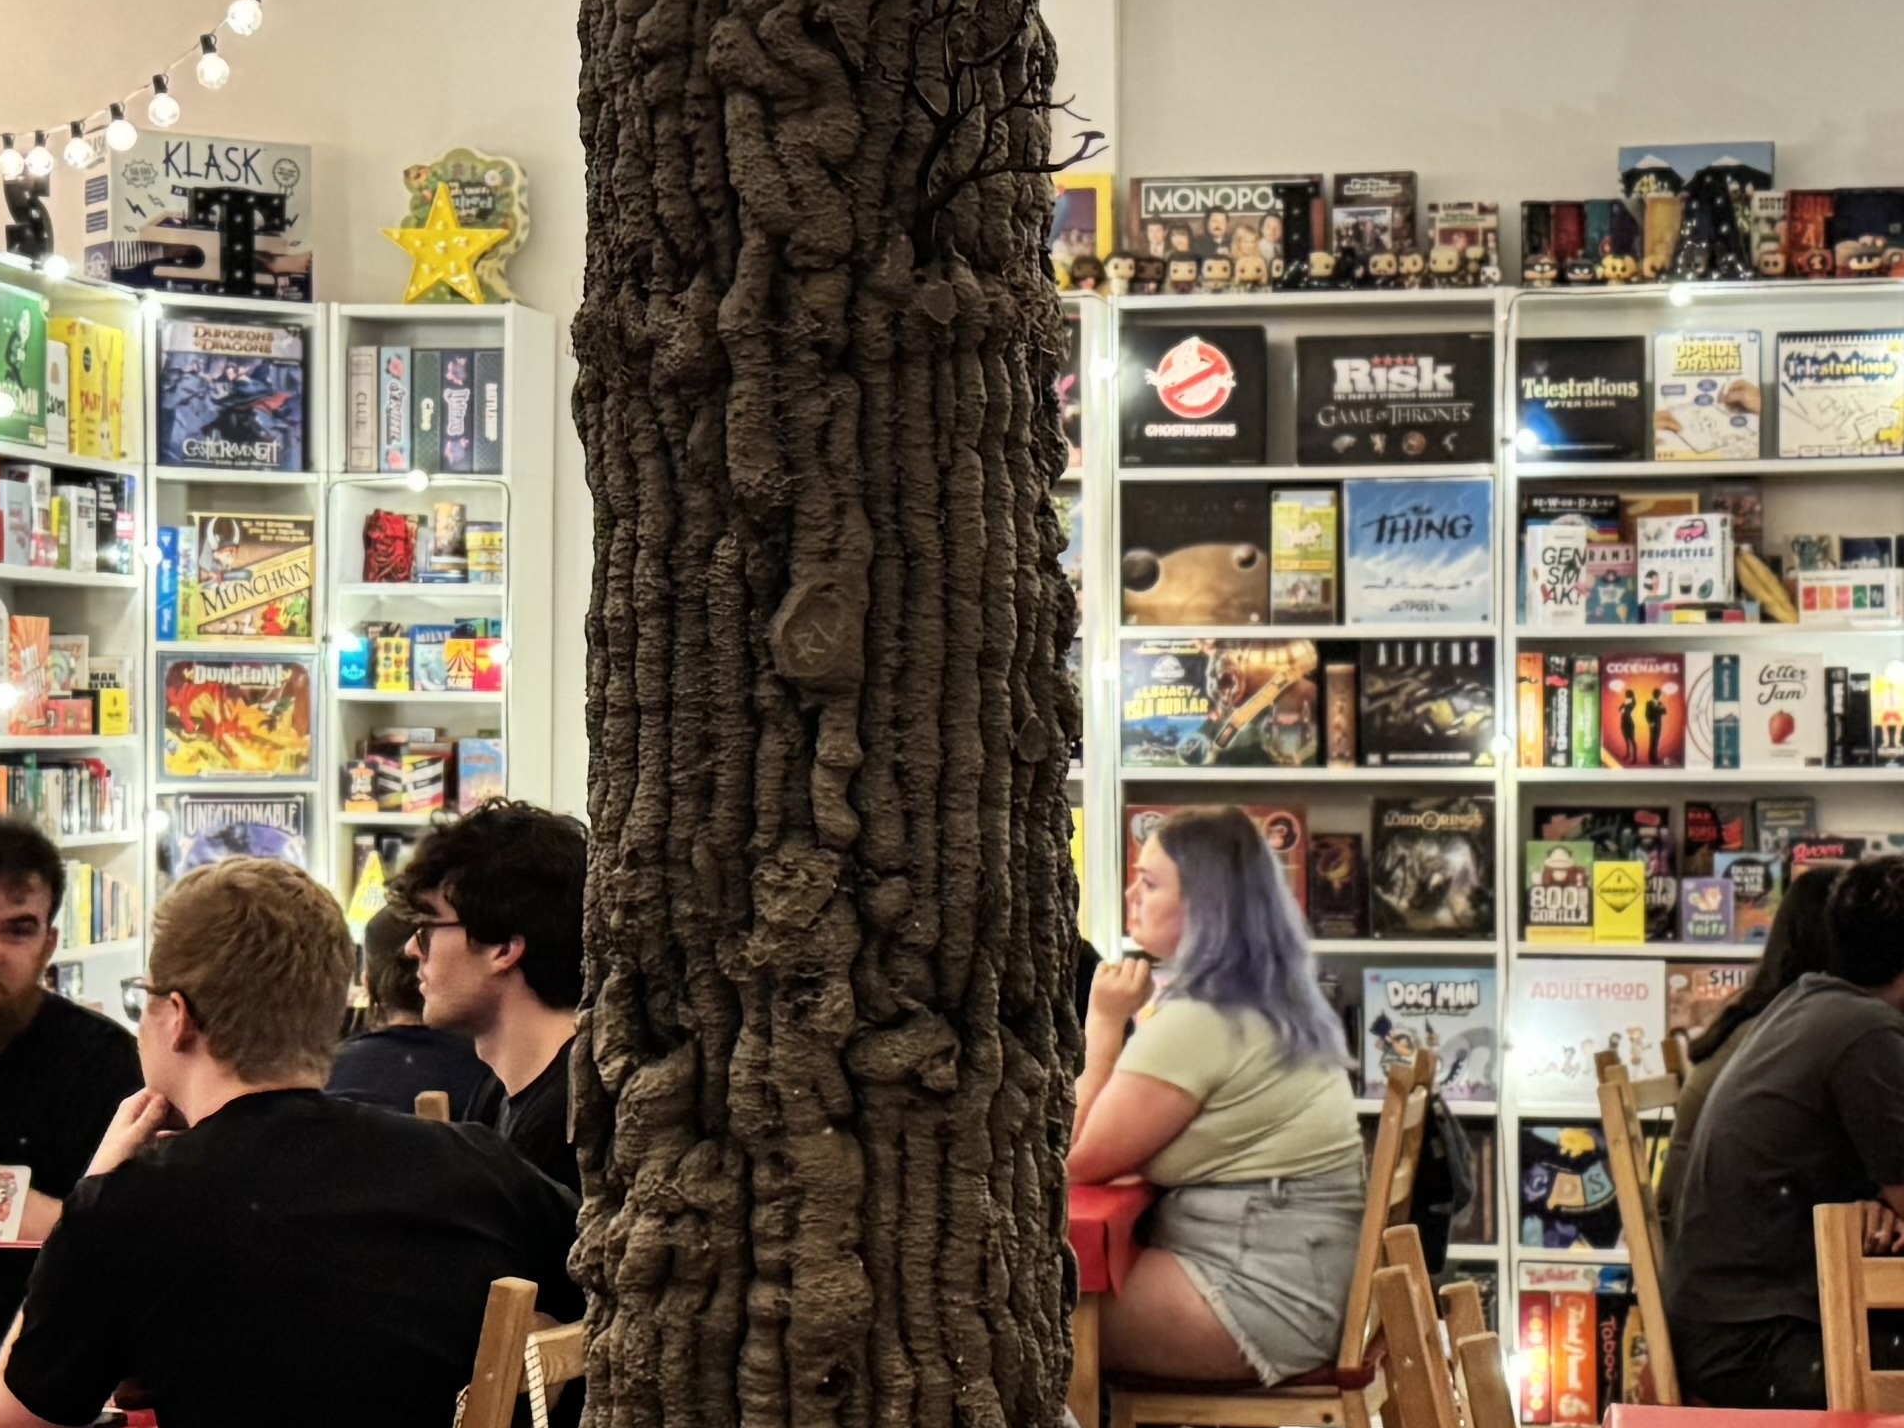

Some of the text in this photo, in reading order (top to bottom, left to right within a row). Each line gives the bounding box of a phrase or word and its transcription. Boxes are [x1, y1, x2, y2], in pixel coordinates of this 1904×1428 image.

[162, 142, 263, 187] KLASK
[1148, 186, 1283, 212] MONOPO
[192, 326, 276, 342] DUNGEONS
[1673, 343, 1742, 359] UPSIDE
[1674, 357, 1743, 373] DRAWN
[1521, 377, 1639, 401] Telestrations
[1317, 406, 1375, 428] GAME
[1389, 403, 1473, 427] THRONES
[1543, 399, 1616, 409] AFTER DARK
[1144, 422, 1238, 438] GHOSTBUSTERS
[1361, 516, 1475, 546] THING
[1542, 547, 1587, 566] GEN
[200, 561, 311, 617] MUNCHKIN
[1377, 642, 1480, 667] ALIENS
[1605, 661, 1680, 675] CODENAMES
[1758, 663, 1809, 685] Letter
[1757, 682, 1807, 706] Jam
[186, 801, 299, 835] UNFATHOMABLE
[1530, 908, 1588, 923] GORILLA
[1386, 981, 1432, 1007] DOG
[1437, 980, 1481, 1005] MAN
[1530, 980, 1650, 1001] ADULTHOOD
